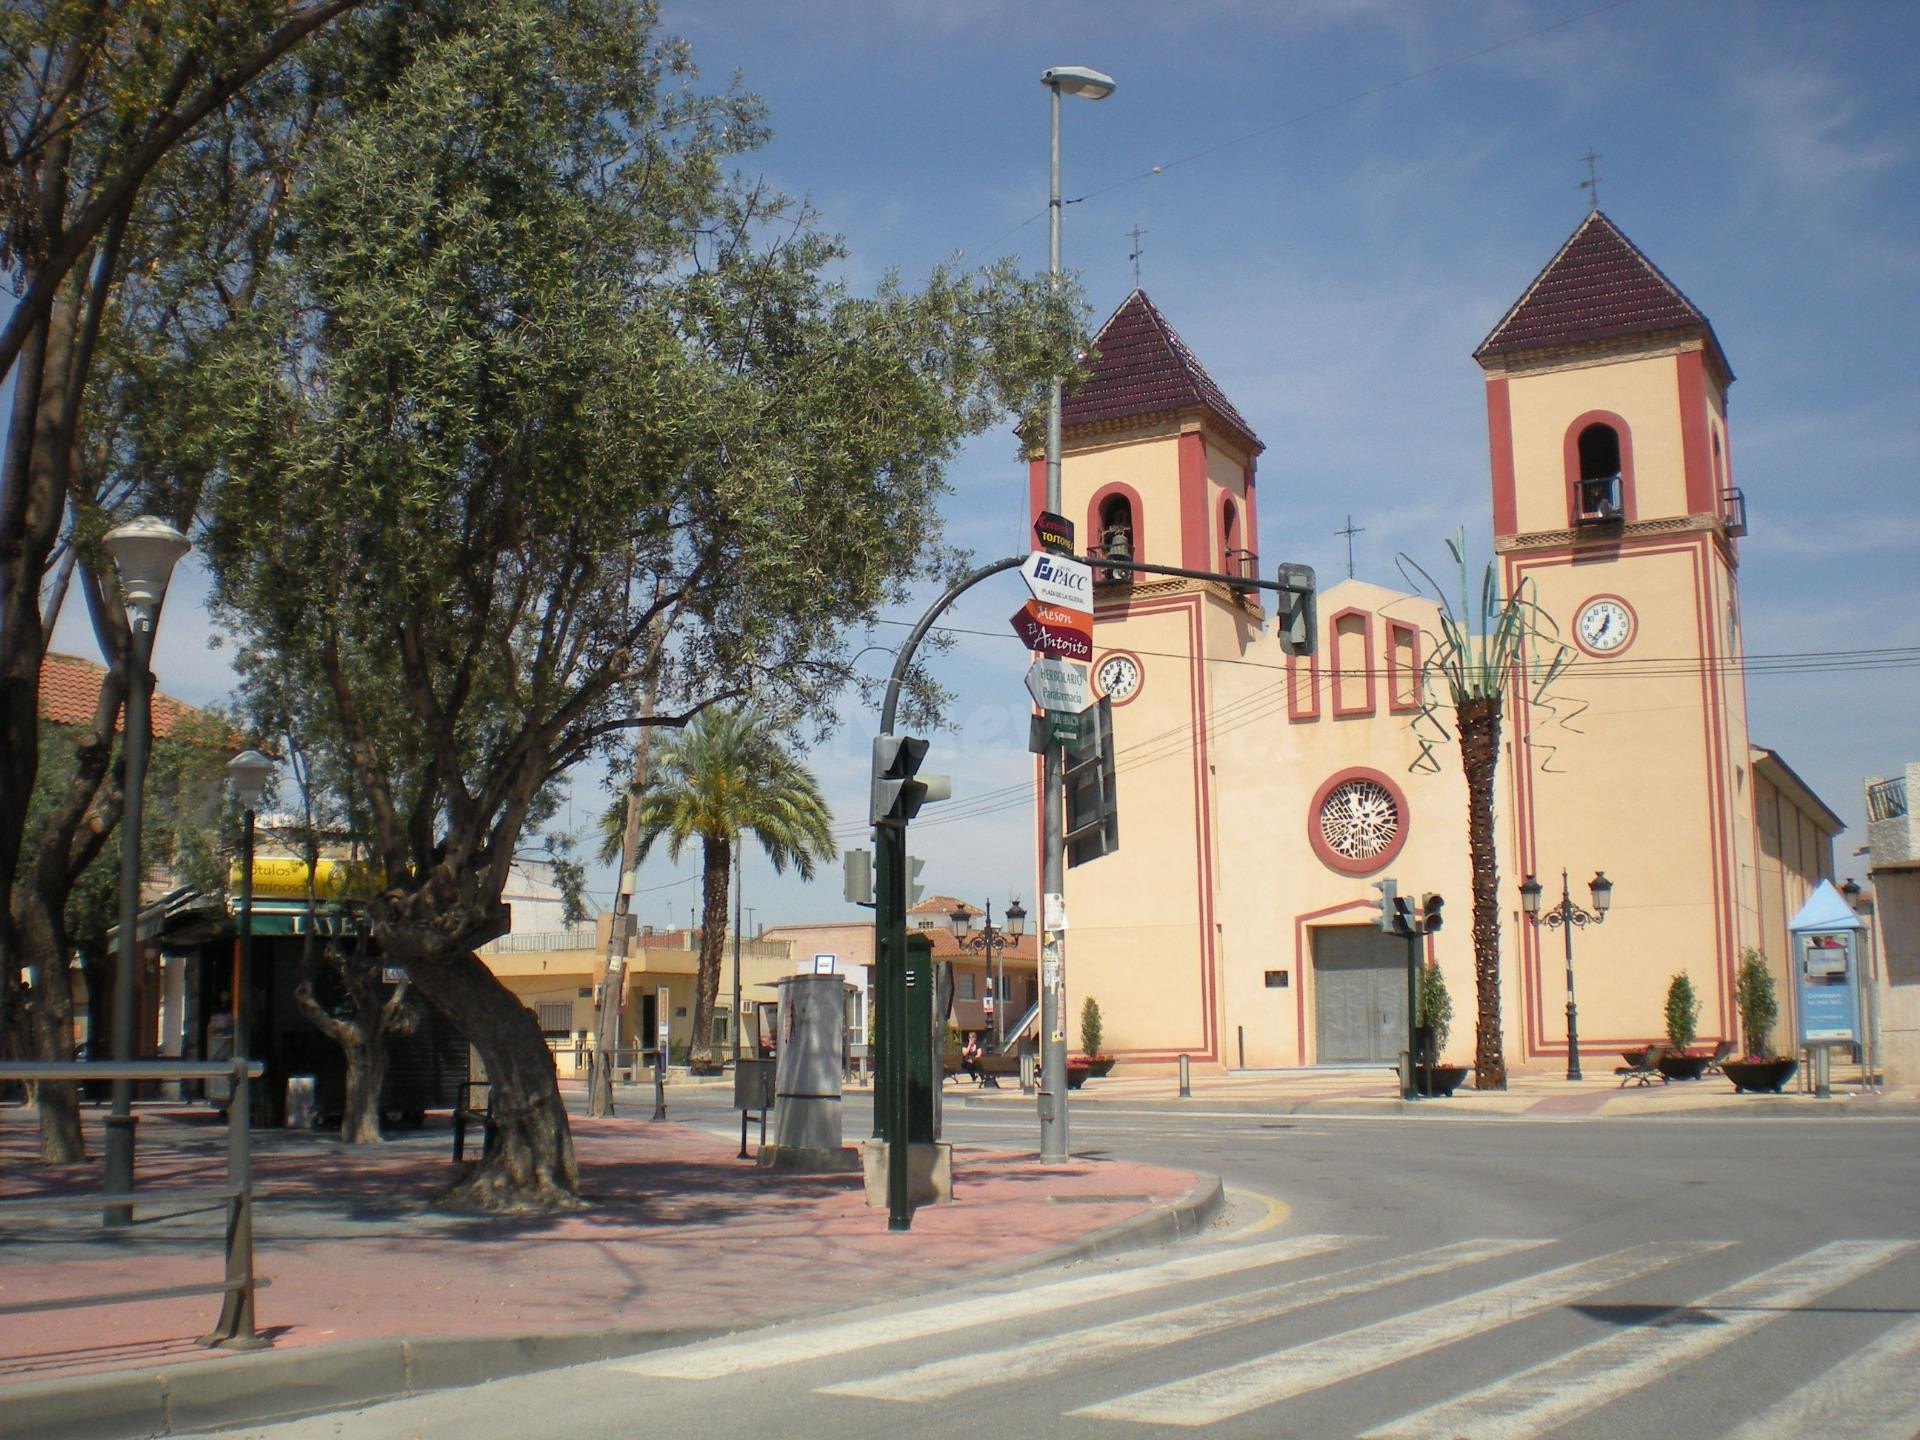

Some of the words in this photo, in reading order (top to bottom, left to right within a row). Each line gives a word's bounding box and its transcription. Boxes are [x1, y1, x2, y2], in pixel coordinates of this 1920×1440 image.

[1052, 568, 1088, 591] PACC
[1027, 622, 1038, 635] El
[1034, 626, 1088, 655] Antojito
[1040, 668, 1083, 685] HERBOLARIO
[1042, 686, 1082, 704] Parafarmacia
[251, 863, 291, 877] ótulos
